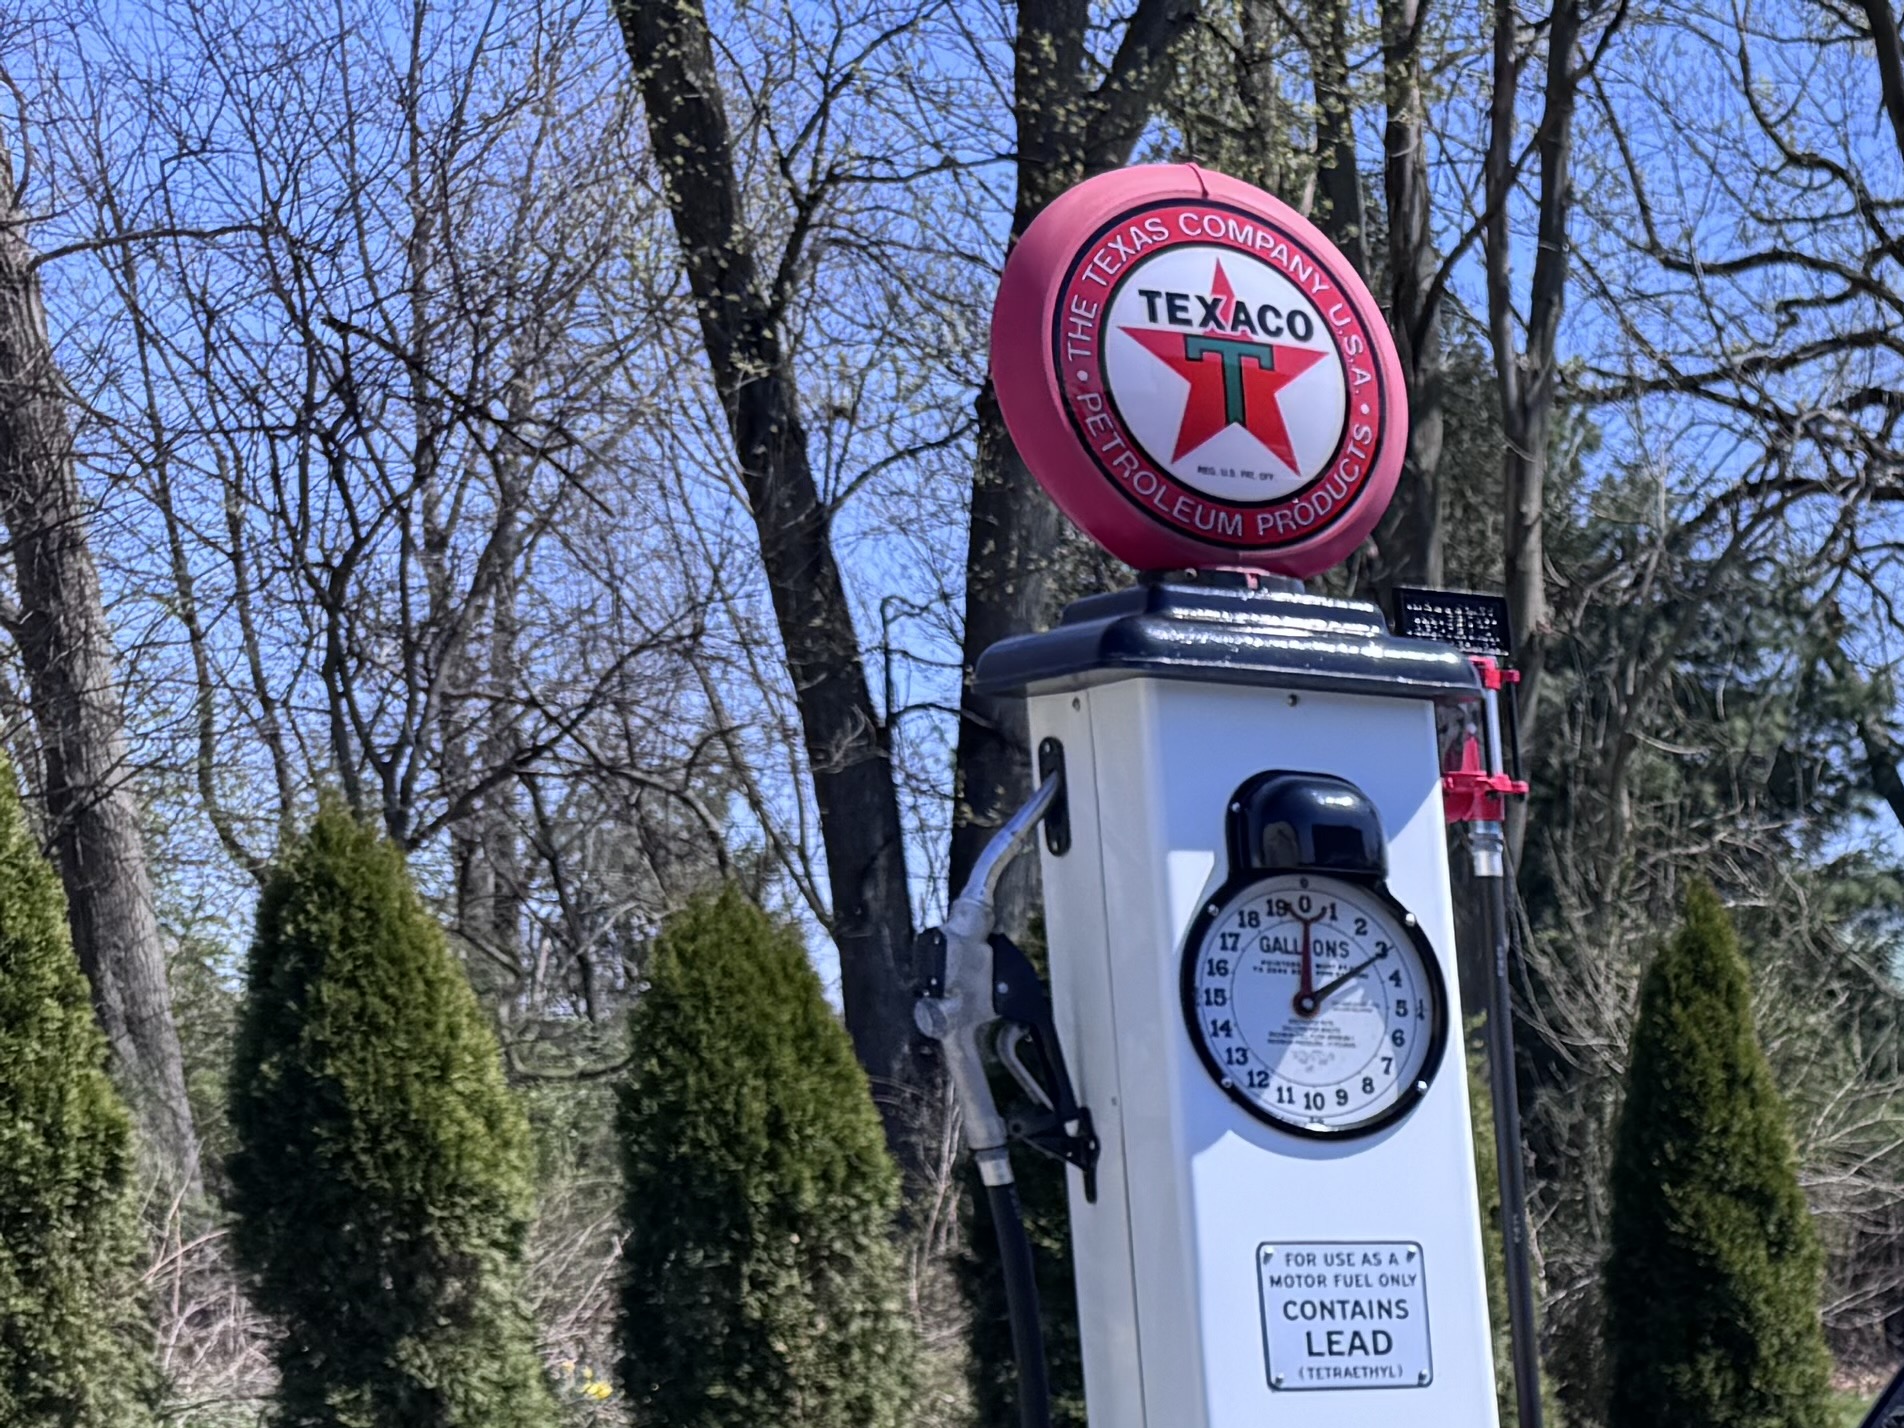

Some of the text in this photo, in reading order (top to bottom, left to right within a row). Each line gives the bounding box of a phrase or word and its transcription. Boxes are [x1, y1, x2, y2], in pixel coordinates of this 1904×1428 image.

[1067, 212, 1373, 396] THE TEXAS COMPANY U.S.A.
[1138, 288, 1314, 342] TEXACO
[1076, 391, 1373, 537] PETROLEUM PRODUCTS
[1299, 894, 1312, 914] 0
[1330, 902, 1339, 921] 1
[1238, 910, 1260, 929] 18
[1354, 918, 1368, 937] 2
[1220, 932, 1240, 951] 17
[1259, 936, 1350, 959] GALLONS
[1375, 941, 1389, 959] 3
[1207, 959, 1229, 976] 16
[1389, 970, 1402, 988] 4
[1204, 987, 1227, 1006] 15
[1395, 999, 1408, 1017] 5
[1210, 1018, 1232, 1038] 14
[1391, 1030, 1405, 1048] 6
[1226, 1047, 1248, 1066] 13
[1380, 1057, 1393, 1076] 7
[1248, 1070, 1269, 1089] 12
[1362, 1076, 1375, 1094] 8
[1276, 1085, 1295, 1104] 11
[1303, 1091, 1325, 1111] 10
[1335, 1088, 1349, 1106] 9
[1285, 1252, 1400, 1267] FOR USE AS A
[1269, 1273, 1417, 1288] MOTOR FUEL ONLY
[1282, 1298, 1410, 1321] CONTAINS
[1306, 1329, 1394, 1357] LEAD
